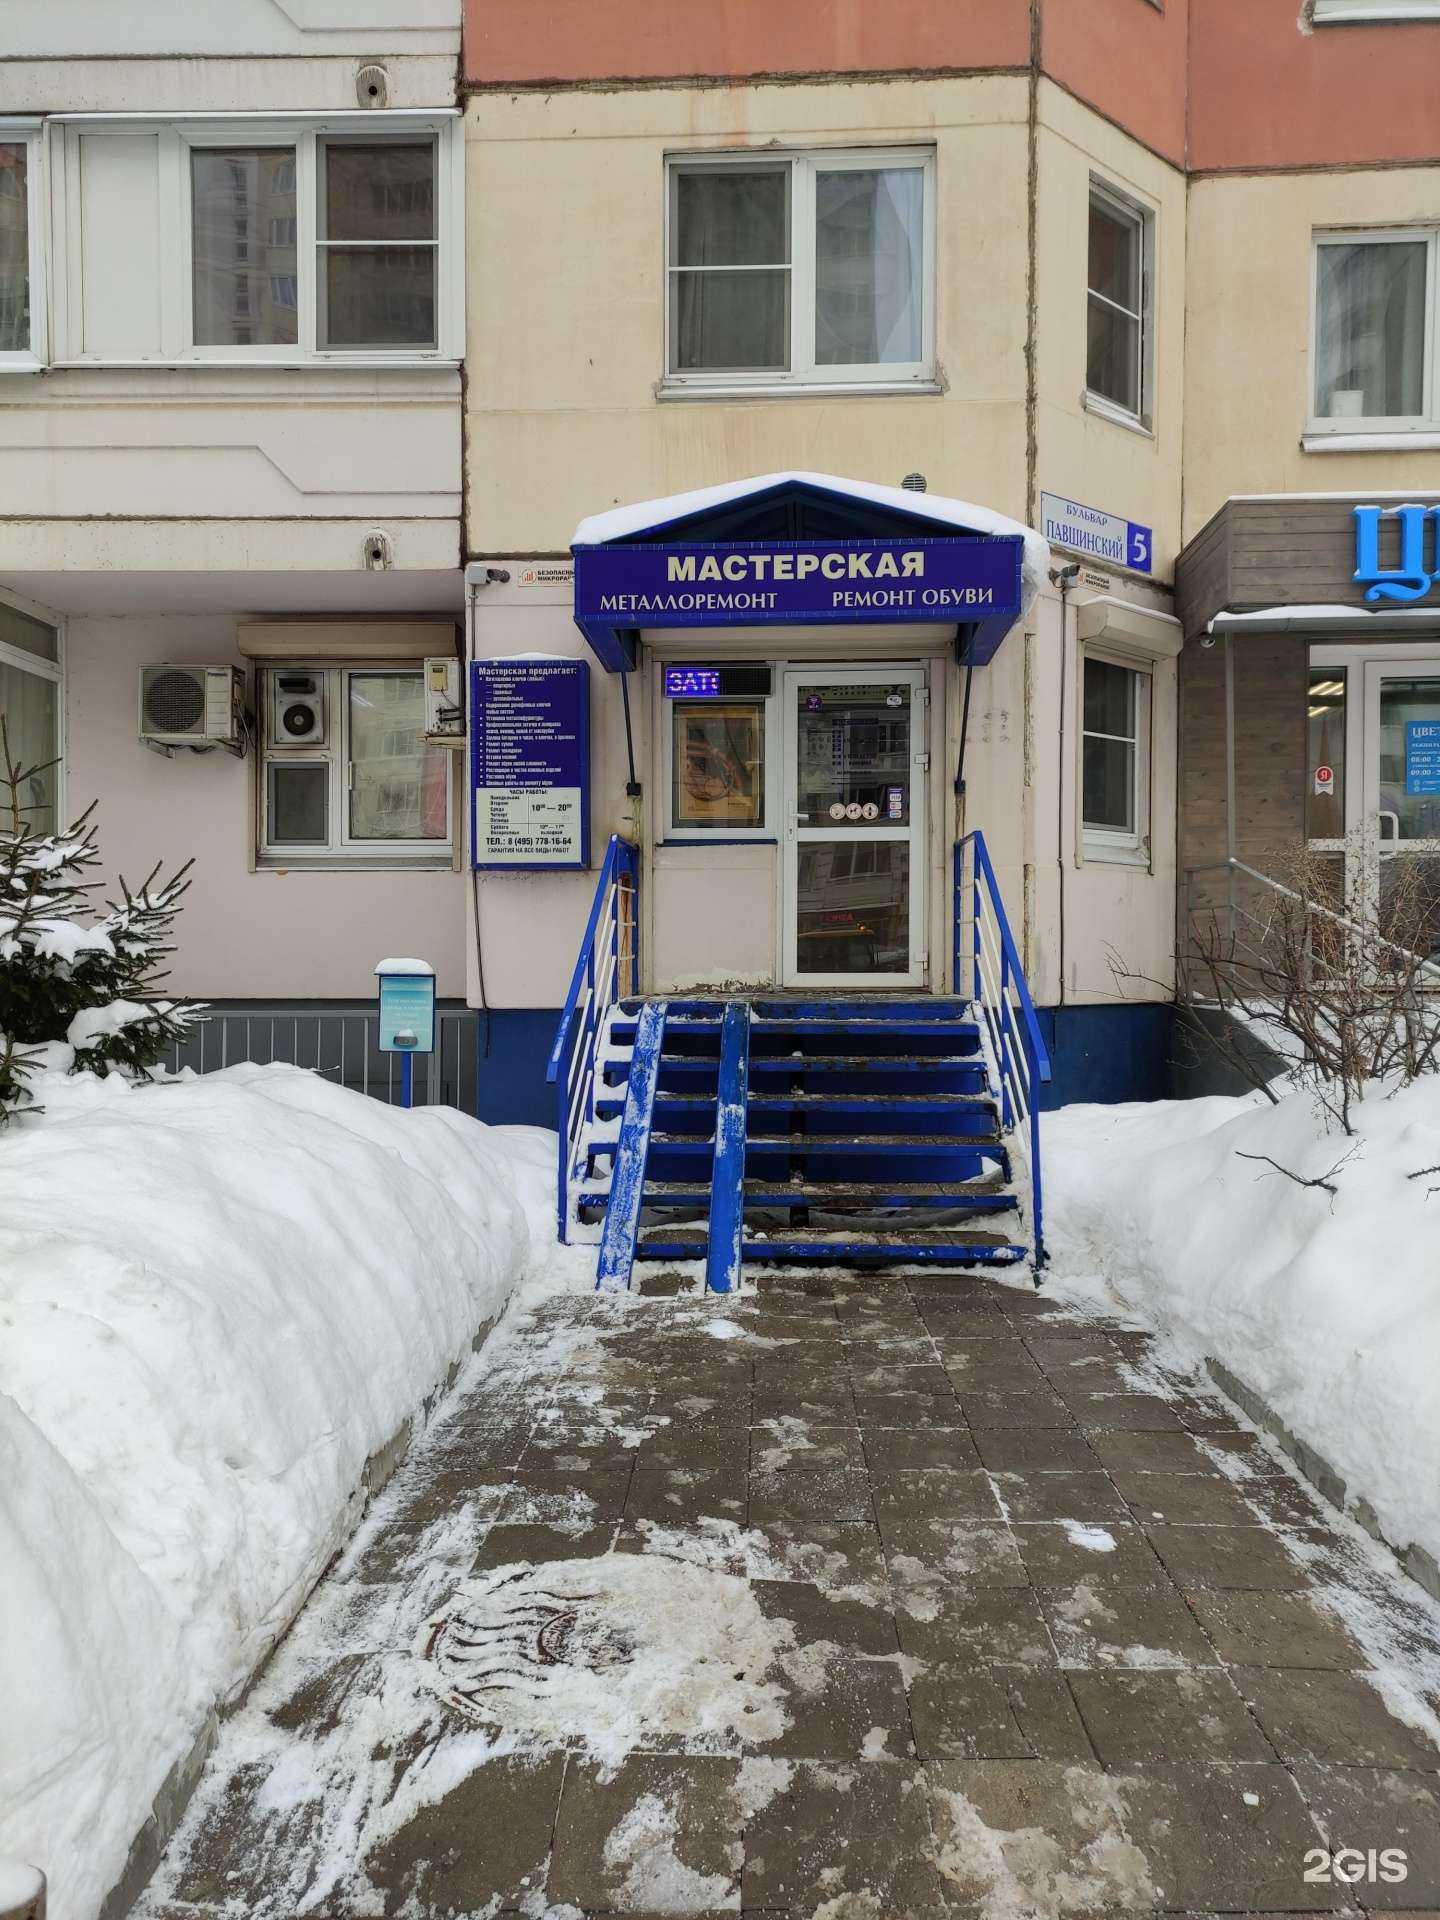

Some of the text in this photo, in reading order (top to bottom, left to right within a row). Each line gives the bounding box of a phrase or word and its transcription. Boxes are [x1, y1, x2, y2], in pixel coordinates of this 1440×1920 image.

[1066, 504, 1108, 526] БУЛЬВАР
[1047, 519, 1123, 561] ПАВШИНСКИЙ
[1133, 533, 1147, 562] 5
[1352, 504, 1440, 602] Ц
[667, 551, 925, 582] МАСТЕРСКАЯ
[600, 592, 778, 611] МЕТАЛЛОРЕМОНТ
[832, 587, 994, 608] РЕМОНТ ОБУВИ
[479, 667, 577, 676] Мастерская предлагает:
[507, 838, 513, 846] 8
[514, 838, 533, 847] (495)
[535, 838, 572, 846] 778-16-64
